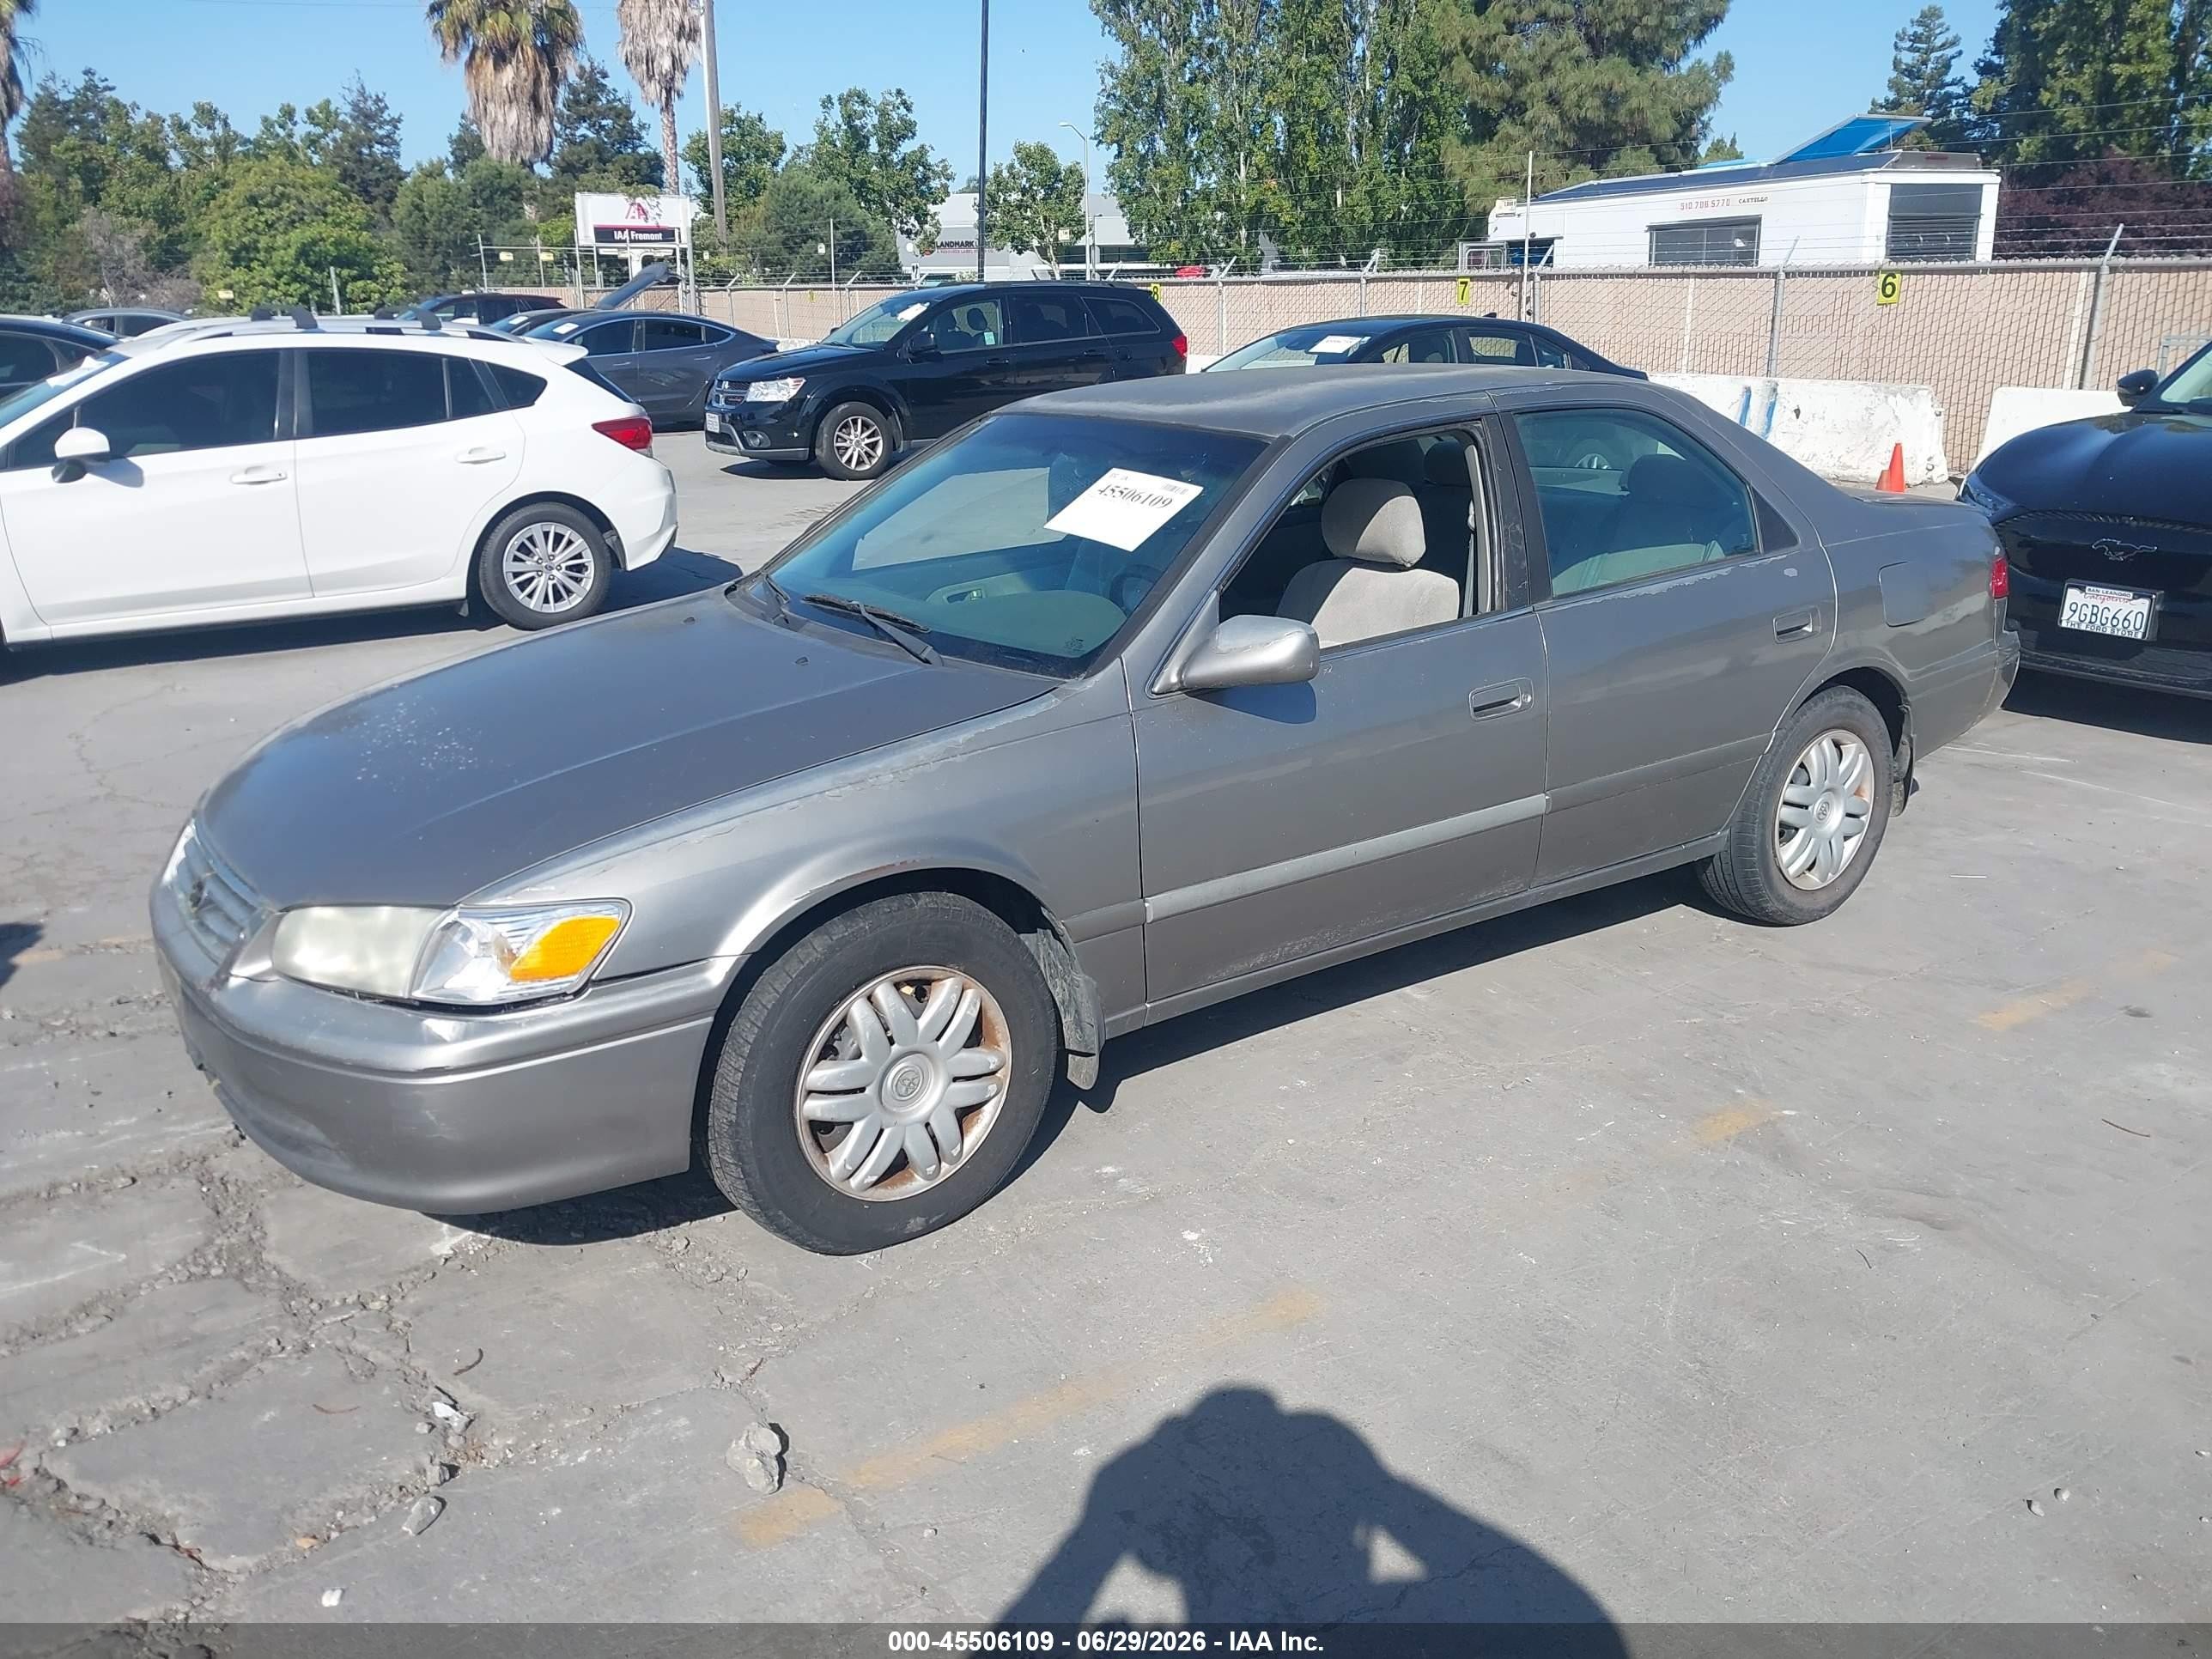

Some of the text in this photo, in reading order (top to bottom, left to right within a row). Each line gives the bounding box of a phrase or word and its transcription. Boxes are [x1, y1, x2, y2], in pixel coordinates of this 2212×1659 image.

[614, 230, 663, 241] IAA Fremont
[935, 240, 975, 248] LANDMARK
[1460, 281, 1468, 301] 7
[1881, 272, 1896, 298] 6
[1152, 286, 1159, 301] 8
[1097, 483, 1173, 509] 45506109
[2101, 589, 2131, 598] LEANDRO
[2068, 602, 2145, 631] 9GBG660
[2086, 624, 2107, 633] FORD
[2111, 629, 2139, 638] STORE
